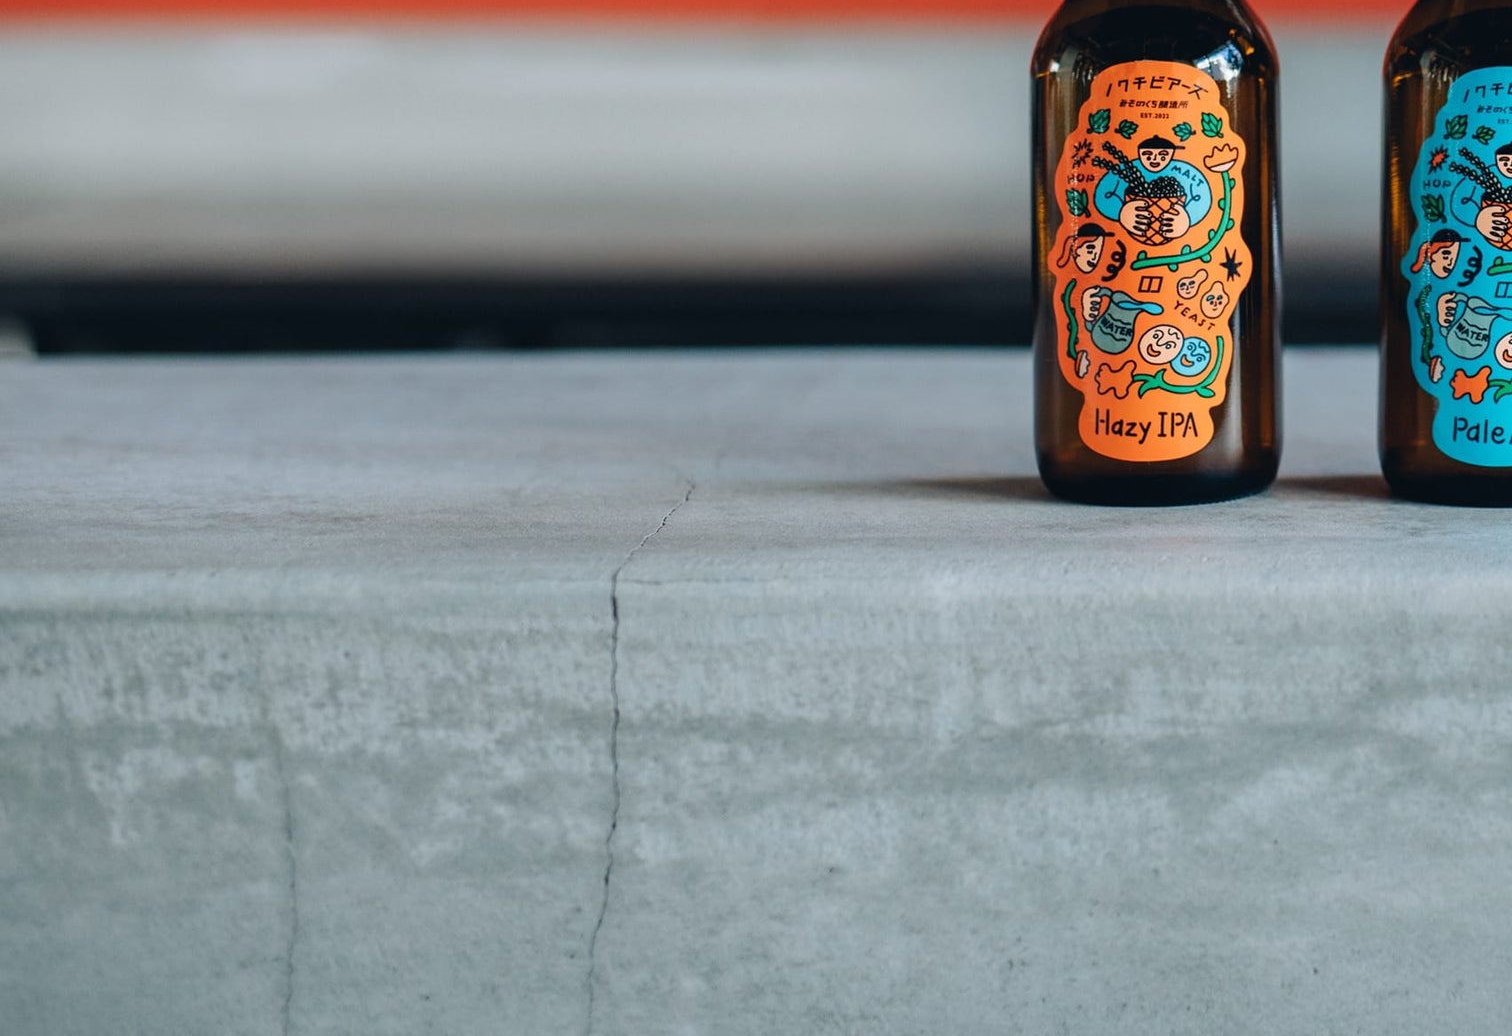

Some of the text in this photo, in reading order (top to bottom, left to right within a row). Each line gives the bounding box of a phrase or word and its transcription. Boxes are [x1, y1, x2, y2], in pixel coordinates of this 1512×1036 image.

[1067, 173, 1095, 184] HOP
[1171, 165, 1205, 188] MALT
[1423, 179, 1452, 190] HOP
[1173, 299, 1216, 331] YEAST
[1100, 317, 1133, 337] WATER
[1455, 322, 1490, 343] WATER
[1094, 408, 1198, 444] Hazy IPA
[1453, 416, 1506, 444] Pale
